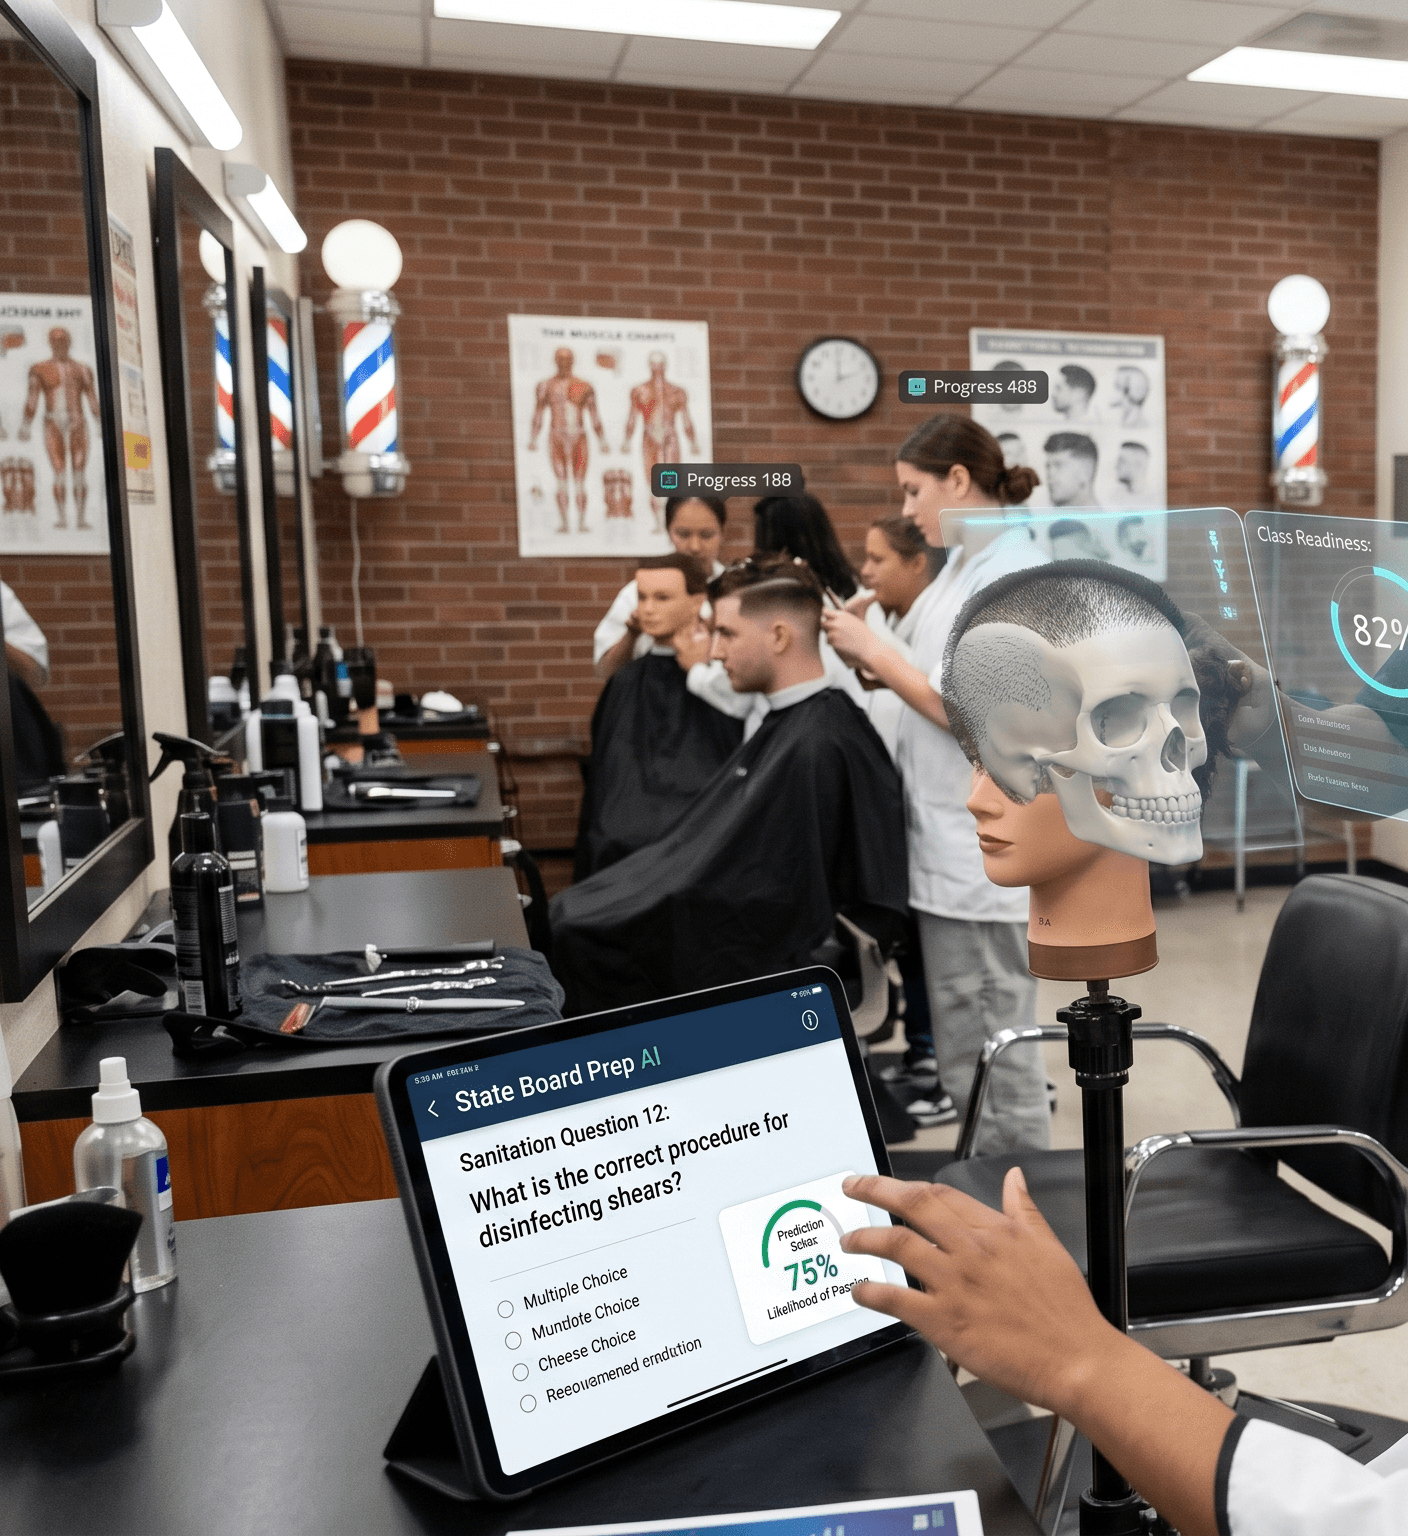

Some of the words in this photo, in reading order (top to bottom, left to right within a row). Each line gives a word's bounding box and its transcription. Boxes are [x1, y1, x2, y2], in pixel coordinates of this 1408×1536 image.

[1257, 526, 1293, 545] Class
[1296, 529, 1372, 553] Readiness:
[455, 1084, 515, 1113] State
[518, 1064, 583, 1098] Board
[586, 1057, 635, 1082] Prep
[641, 1046, 662, 1070] AI
[459, 1135, 557, 1172] Sanitation
[560, 1111, 639, 1147] Question
[642, 1103, 670, 1125] 12:
[469, 1181, 528, 1214] What
[531, 1175, 551, 1198] is
[555, 1167, 590, 1192] the
[594, 1145, 664, 1180] correct
[668, 1122, 761, 1165] procedure
[763, 1111, 789, 1133] for
[479, 1197, 602, 1248] disinfecting
[607, 1171, 683, 1211] shears?
[777, 1219, 825, 1242] Prediction
[523, 1281, 580, 1310] Multiple
[582, 1267, 628, 1291] Choice
[784, 1254, 838, 1291] 75%
[594, 1296, 641, 1320] Choice
[767, 1292, 818, 1320] Likelihood
[820, 1287, 831, 1301] of
[538, 1345, 589, 1372] Cheese
[591, 1328, 637, 1353] Choice
